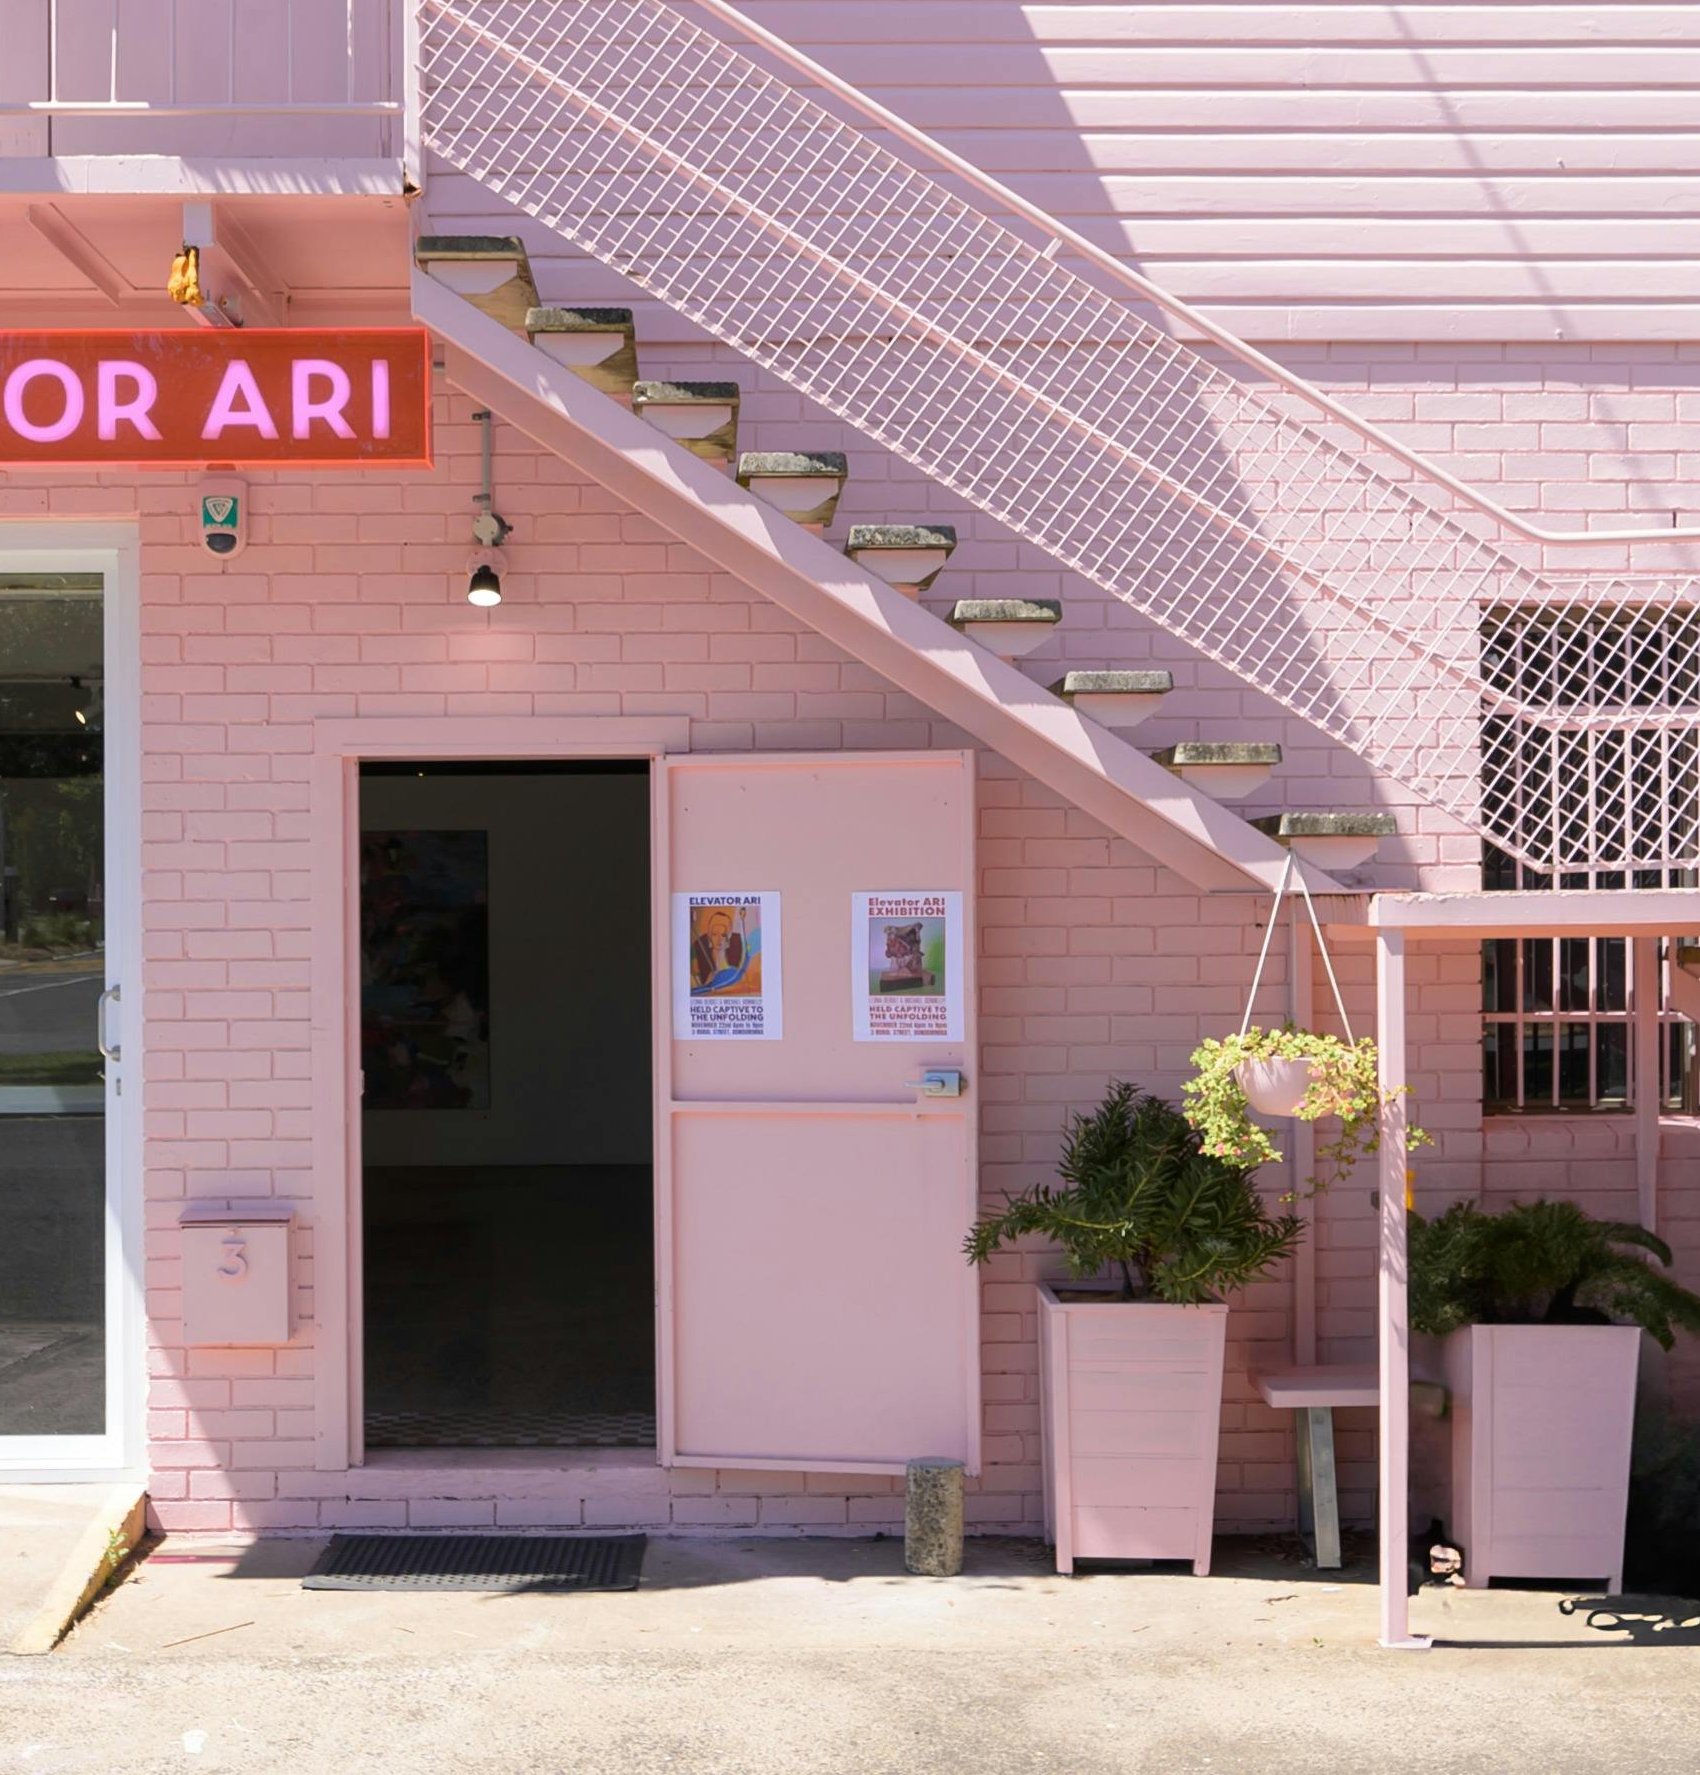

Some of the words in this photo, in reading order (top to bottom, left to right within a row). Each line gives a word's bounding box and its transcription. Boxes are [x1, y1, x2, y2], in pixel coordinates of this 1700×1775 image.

[200, 358, 390, 441] ARI
[689, 896, 741, 906] ELEVATOR
[742, 896, 761, 905] ARI
[868, 897, 921, 907] Elevator
[922, 897, 946, 907] ARI
[868, 907, 946, 916] EXHIBITION
[217, 1239, 249, 1278] 3
